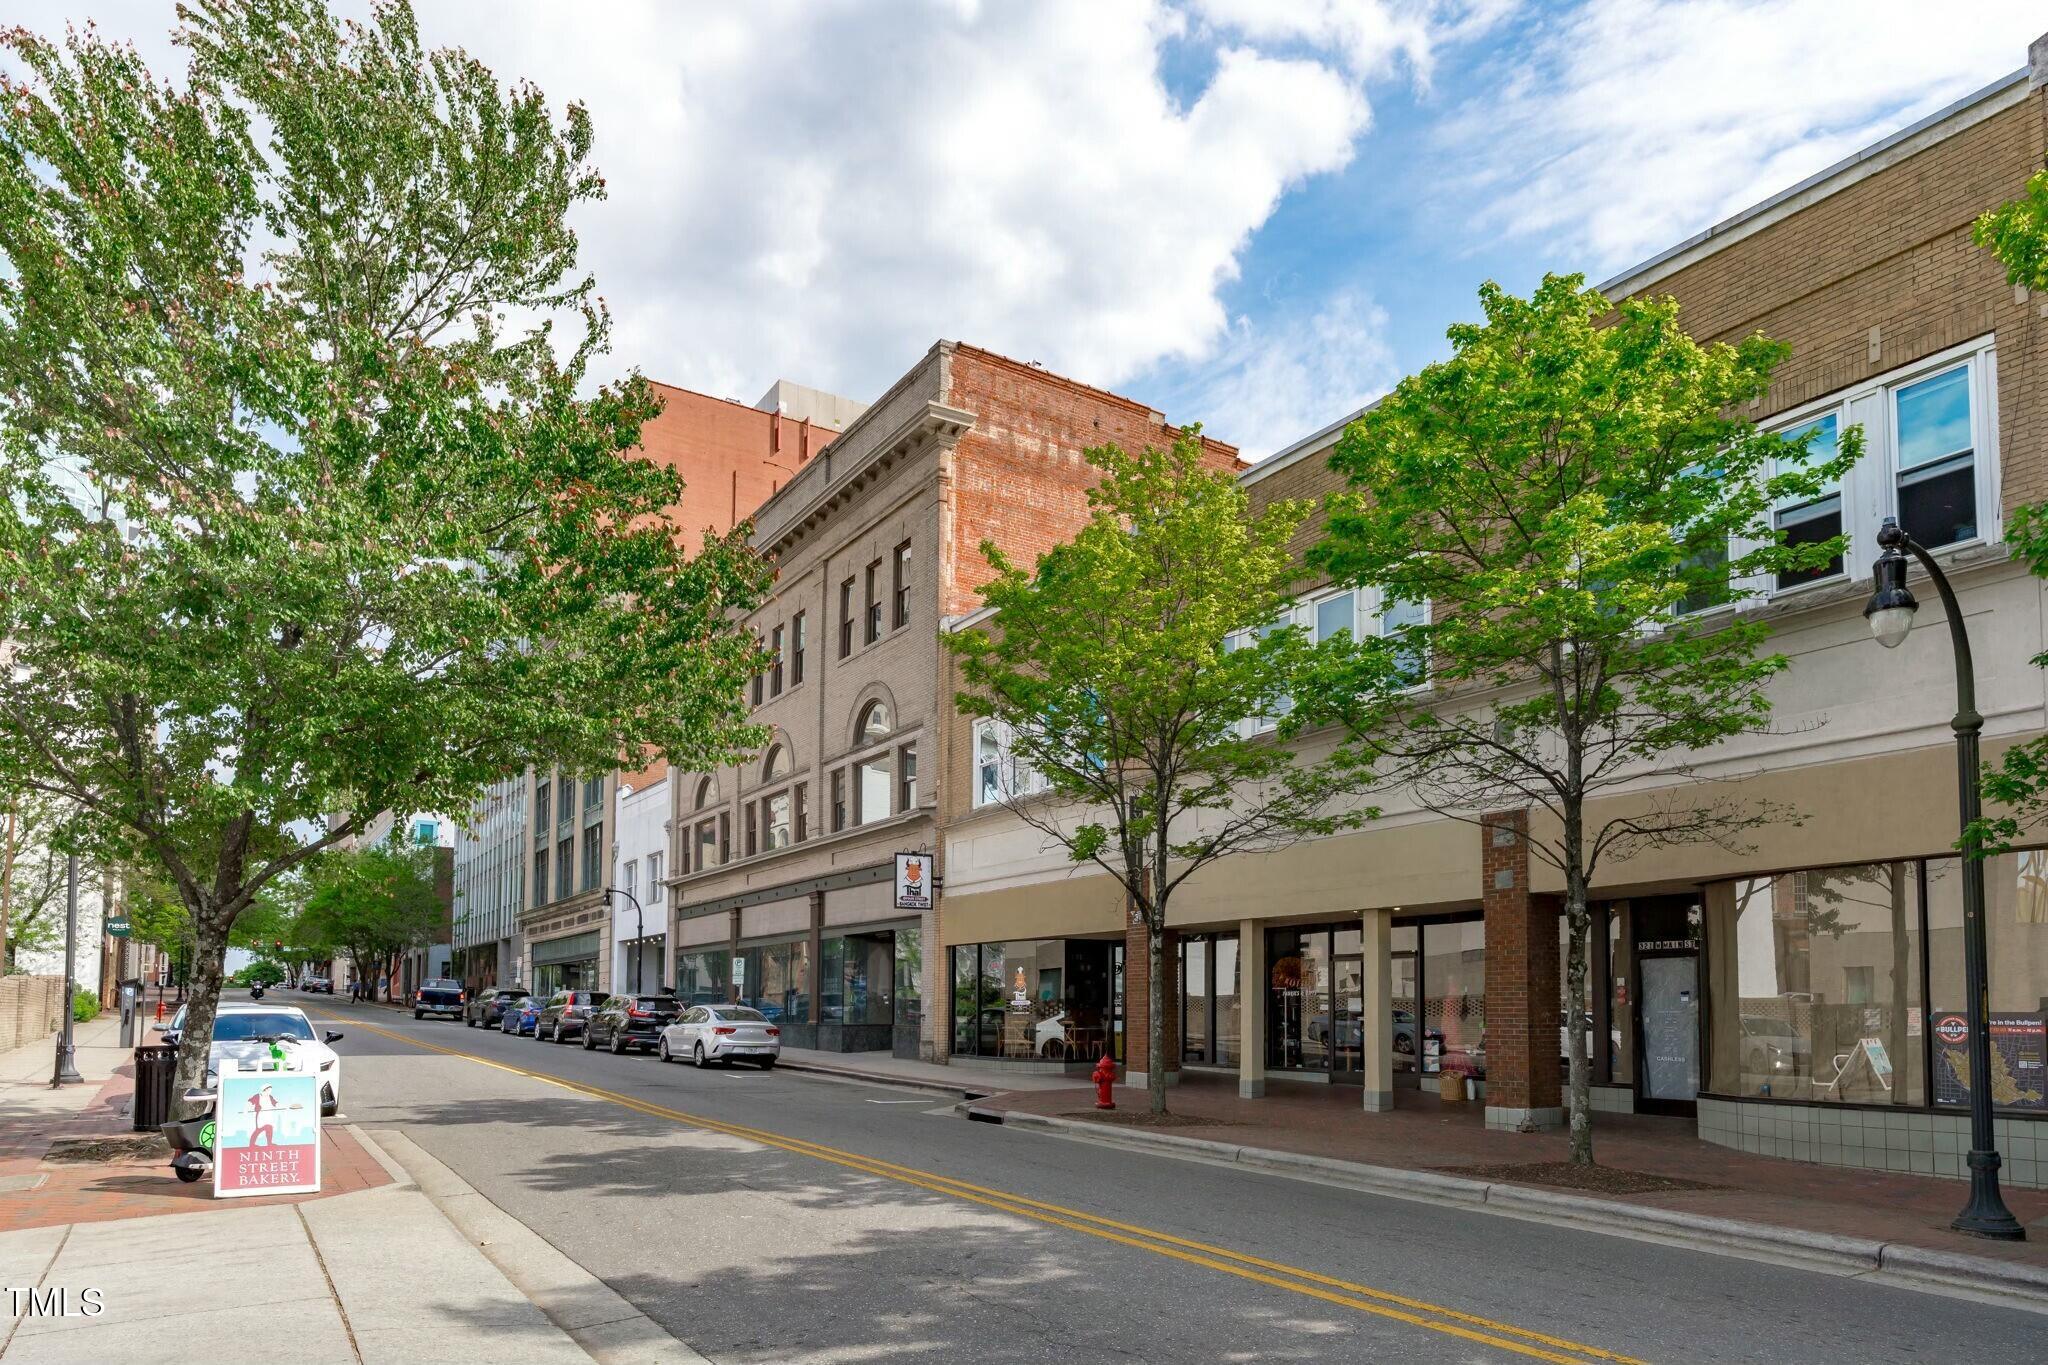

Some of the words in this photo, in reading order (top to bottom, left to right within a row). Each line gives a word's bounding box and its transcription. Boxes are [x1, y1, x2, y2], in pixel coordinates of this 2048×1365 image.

[1663, 941, 1684, 949] MAIN
[240, 1150, 300, 1162] NINTH
[239, 1161, 299, 1174] STREET
